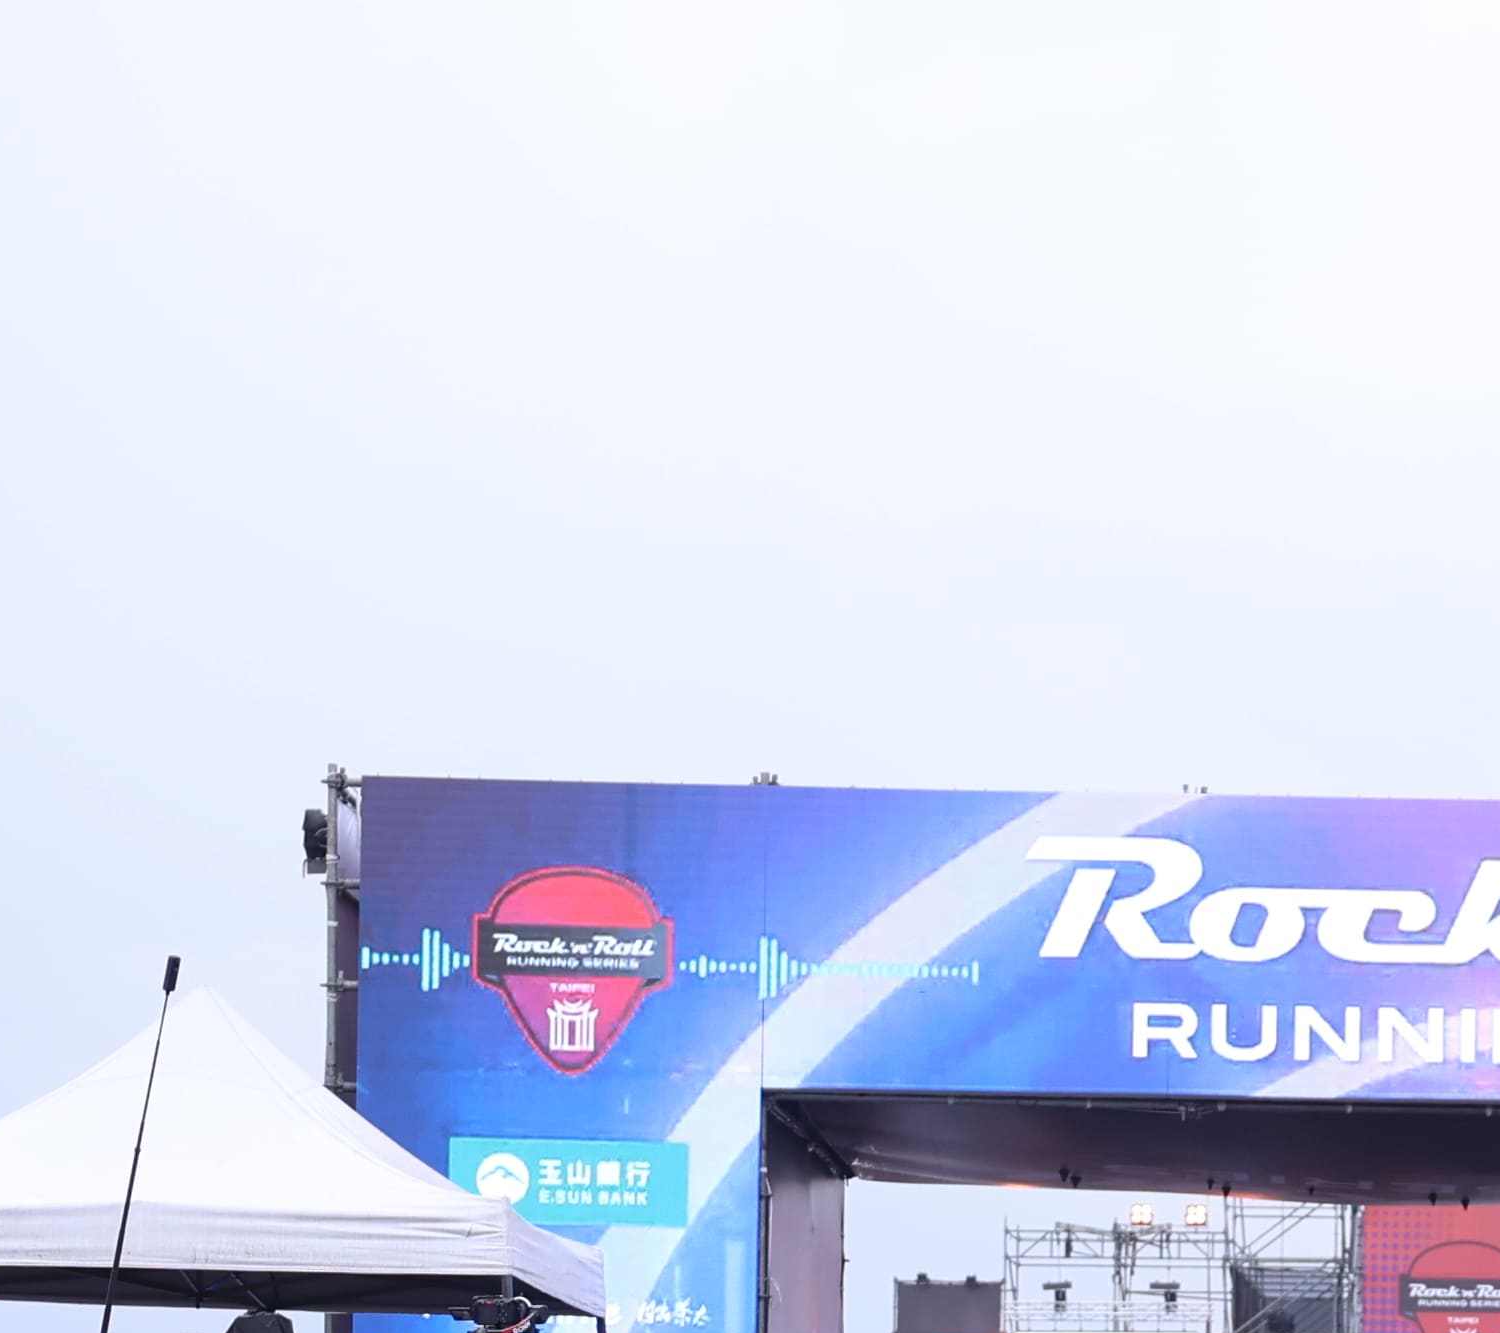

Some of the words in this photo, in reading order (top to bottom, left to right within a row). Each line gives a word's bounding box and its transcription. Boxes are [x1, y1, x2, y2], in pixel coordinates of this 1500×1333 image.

[492, 933, 568, 954] Rock
[592, 934, 655, 956] Roll
[506, 957, 579, 968] RUNNING
[550, 982, 596, 994] TAIPEI
[597, 1190, 648, 1207] BANK
[1408, 1283, 1460, 1298] Rock
[1417, 1299, 1468, 1307] RUNNING
[1447, 1316, 1479, 1324] TAIPEI
